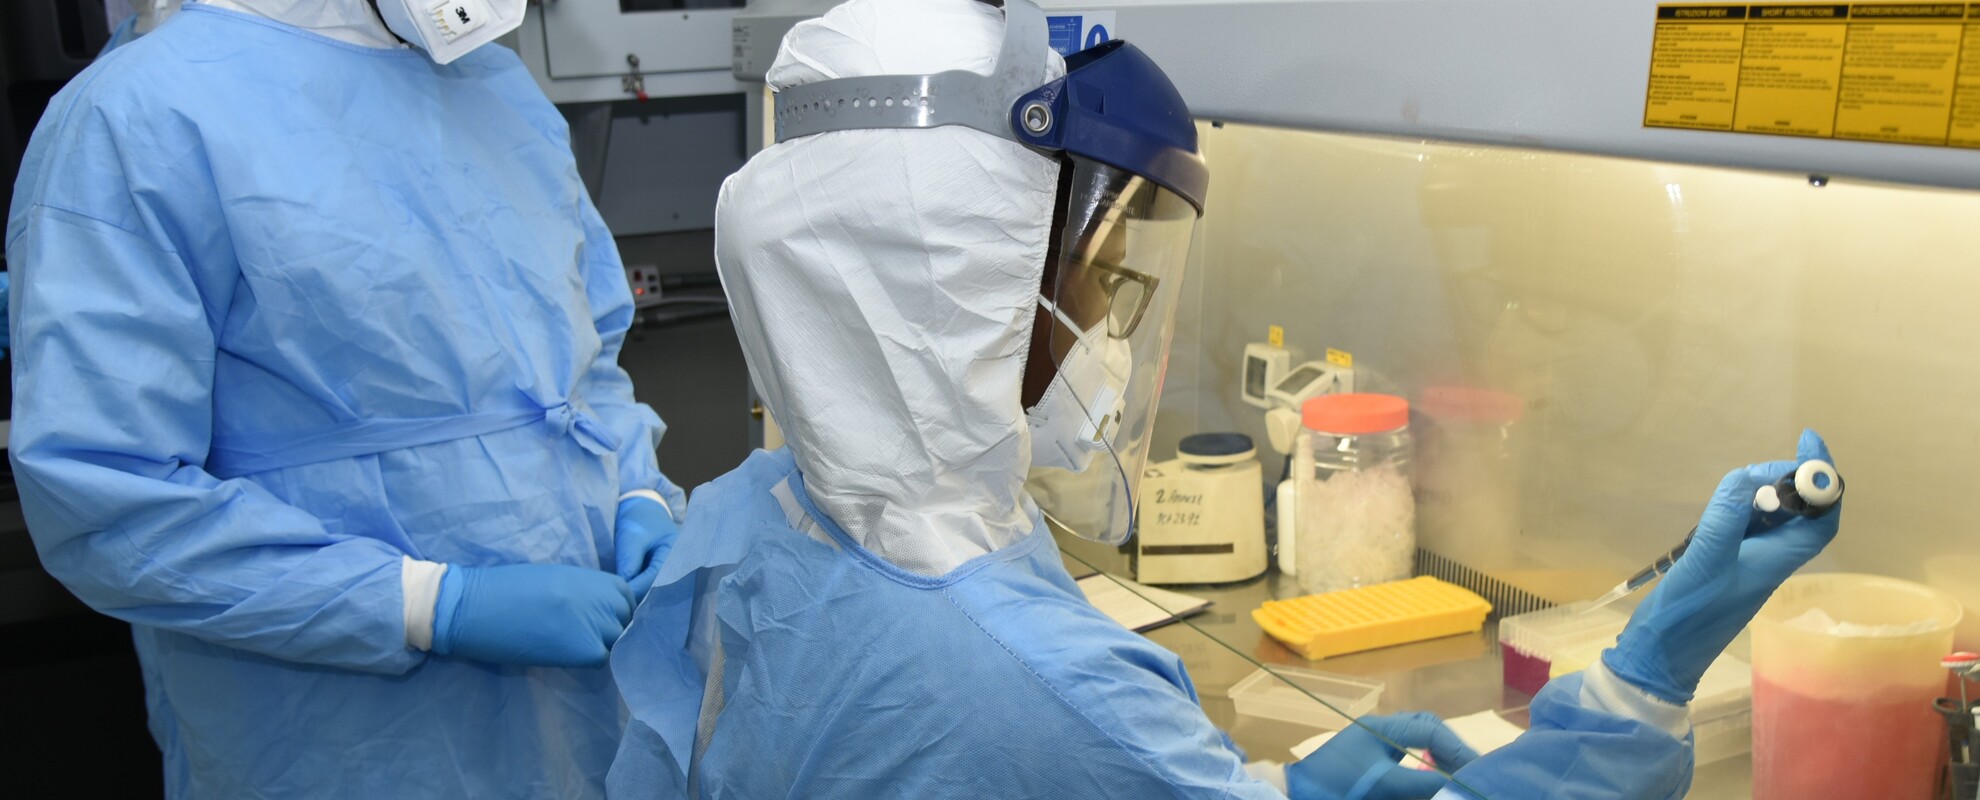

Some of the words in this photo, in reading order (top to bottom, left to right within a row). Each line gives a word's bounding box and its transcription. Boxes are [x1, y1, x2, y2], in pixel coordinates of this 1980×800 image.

[455, 6, 471, 24] 3M
[1761, 8, 1784, 17] SHORT
[1785, 8, 1835, 17] INSTRUCTIONS
[1156, 488, 1166, 504] 2
